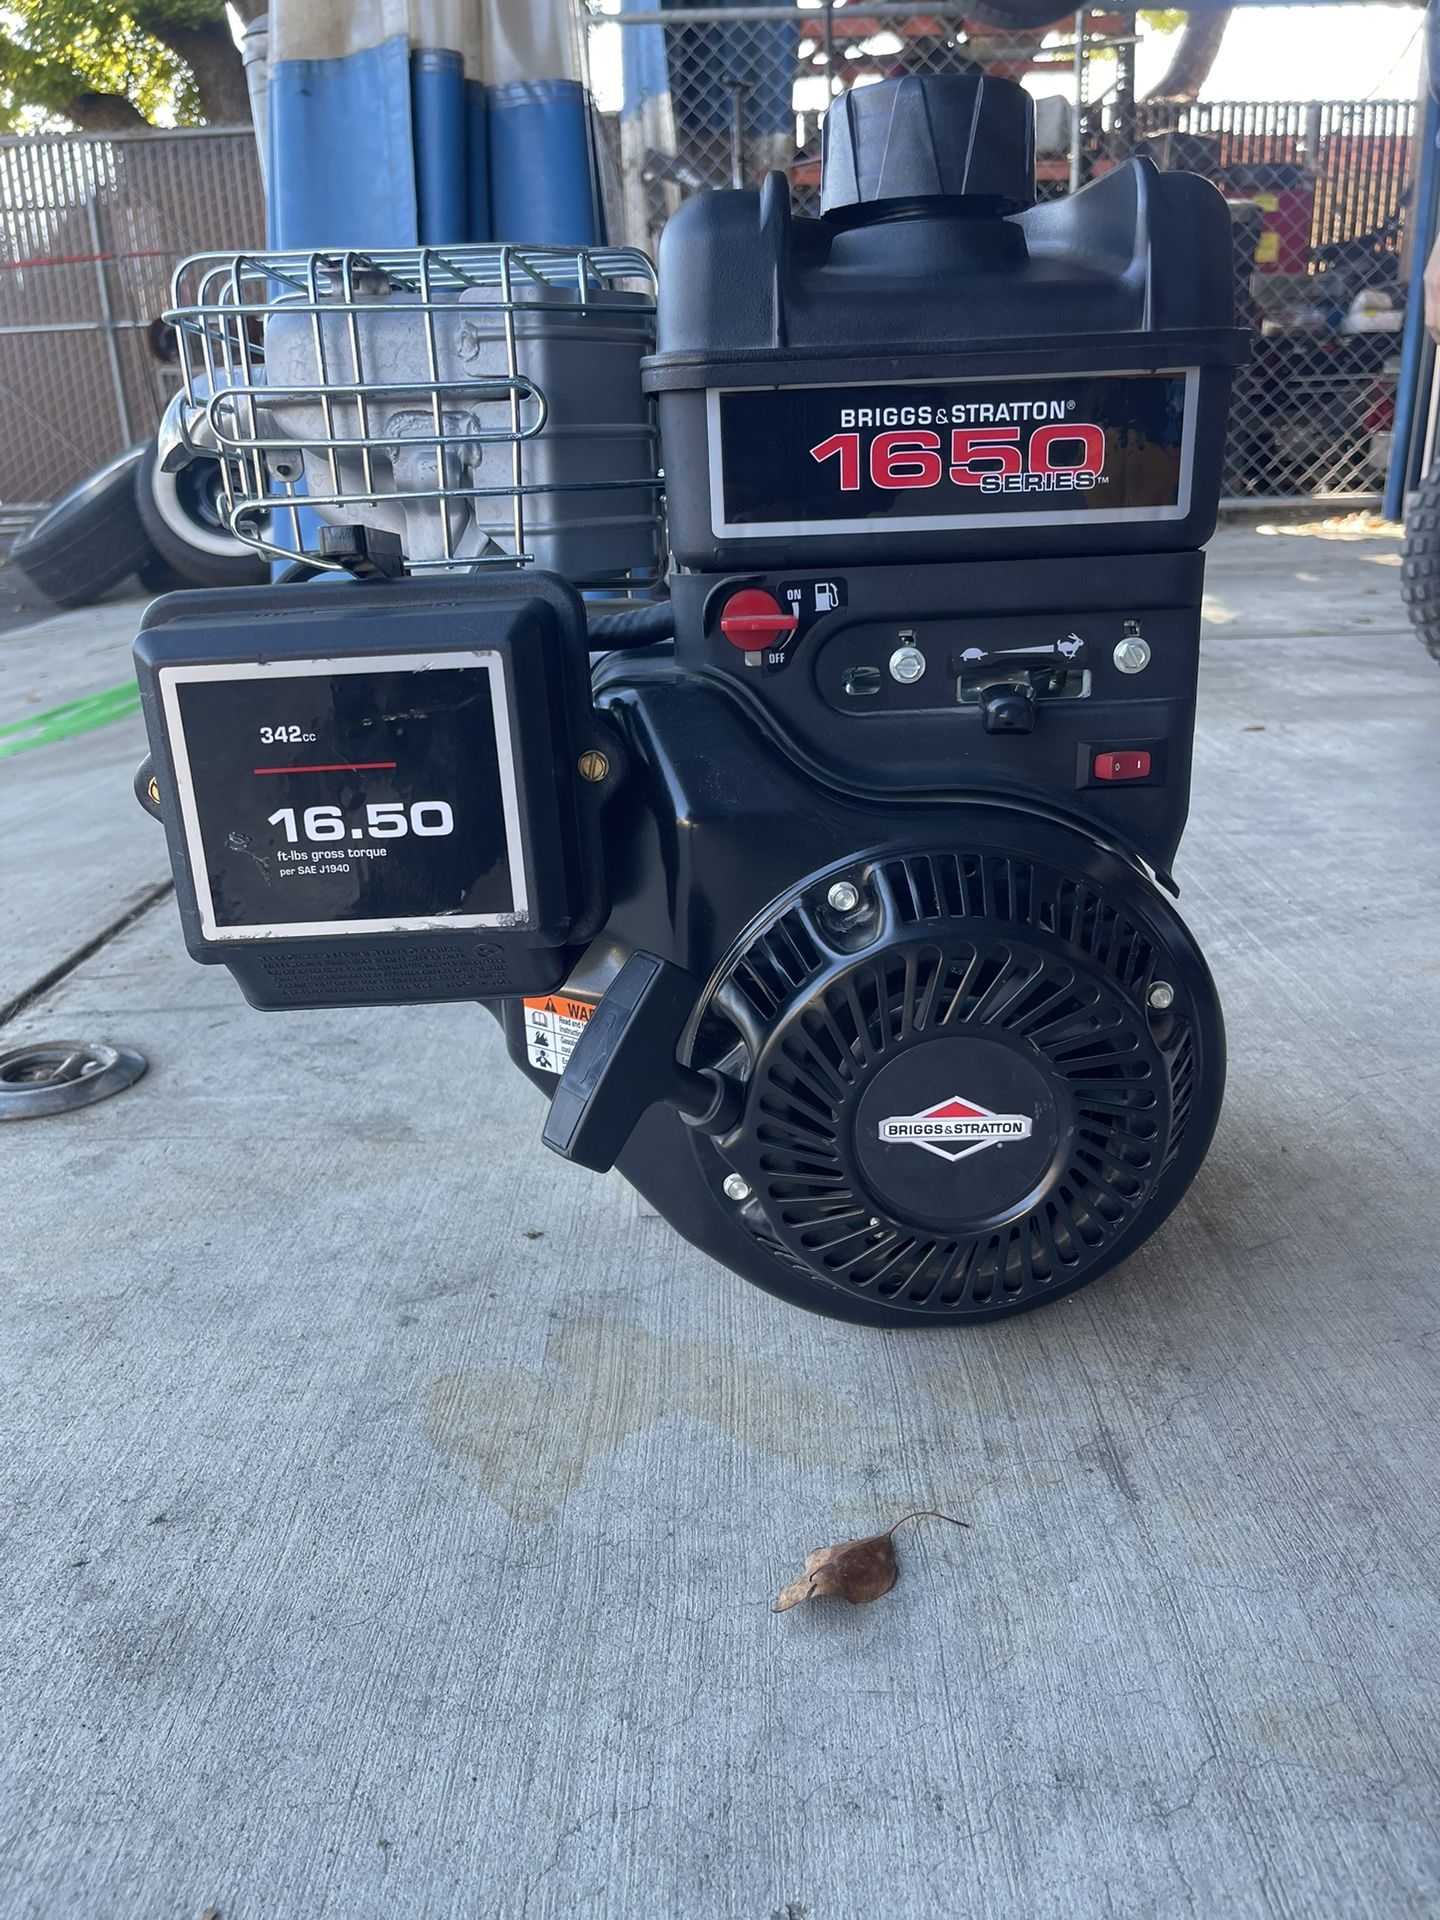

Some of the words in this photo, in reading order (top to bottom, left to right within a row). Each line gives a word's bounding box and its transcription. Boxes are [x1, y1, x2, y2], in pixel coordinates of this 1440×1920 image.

[809, 423, 1106, 491] 1650
[786, 589, 802, 601] ON
[768, 652, 785, 664] OFF
[267, 800, 455, 843] 16.50
[277, 850, 309, 862] ft-lbs
[311, 849, 345, 863] gross
[347, 847, 387, 859] torque
[279, 867, 296, 878] per
[297, 865, 317, 875] SAE
[319, 863, 350, 875] J1940
